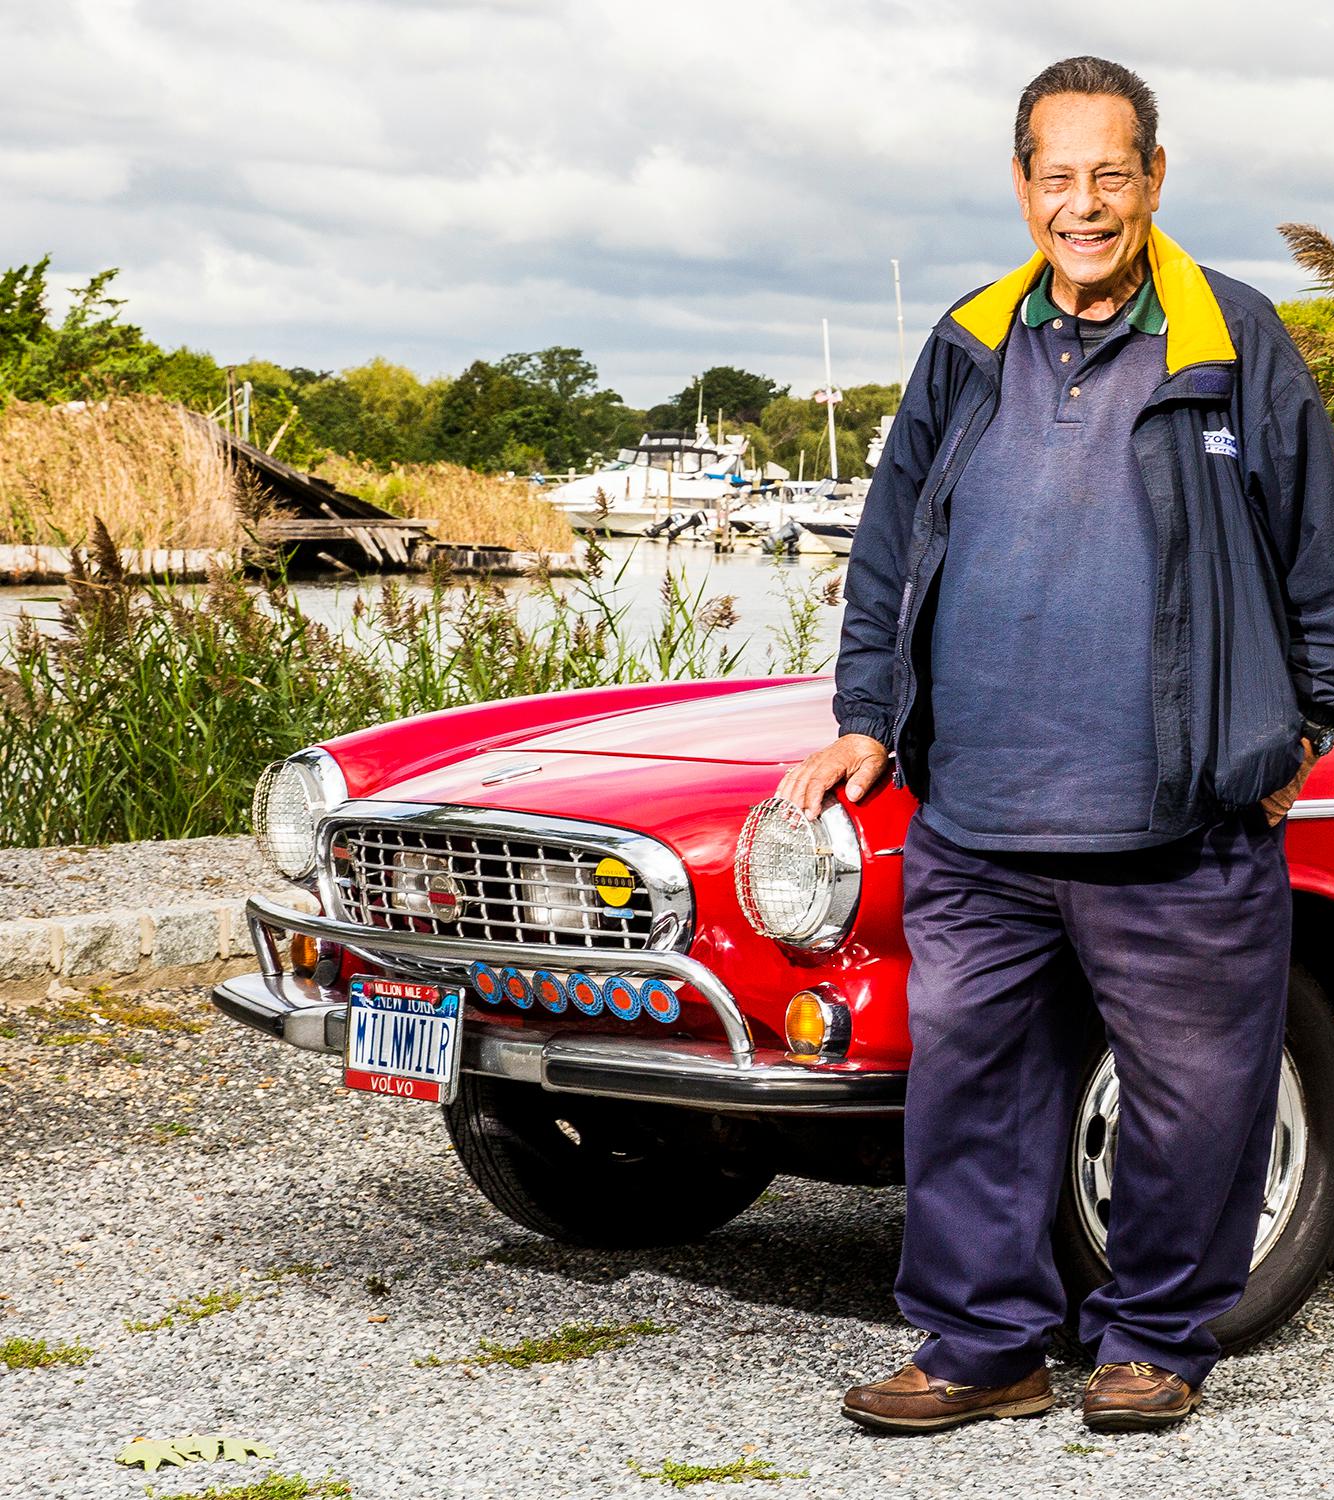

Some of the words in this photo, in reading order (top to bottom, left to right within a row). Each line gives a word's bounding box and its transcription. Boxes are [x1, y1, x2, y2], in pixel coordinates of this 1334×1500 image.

[374, 983, 403, 996] MILLION
[404, 986, 421, 998] MILE
[377, 997, 403, 1009] NEW
[355, 1011, 450, 1076] MILNMILR
[370, 1076, 414, 1096] VOLVO
